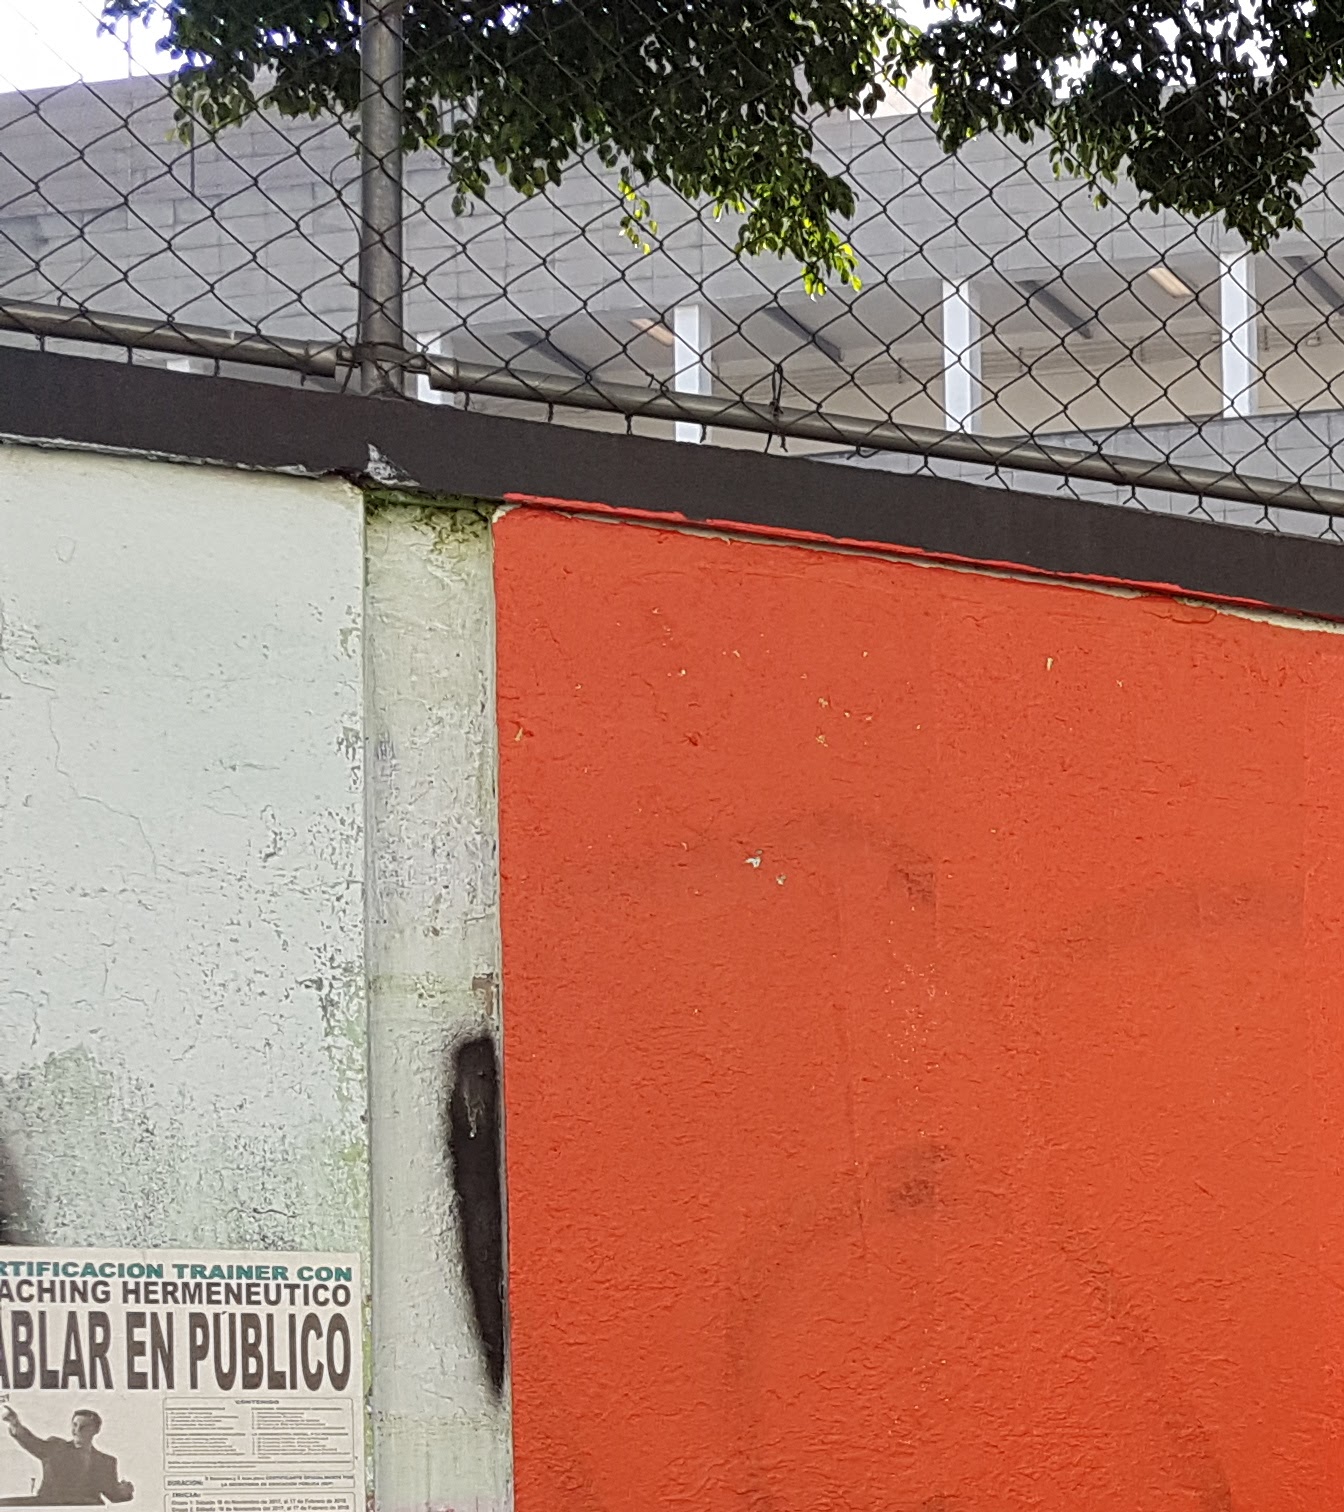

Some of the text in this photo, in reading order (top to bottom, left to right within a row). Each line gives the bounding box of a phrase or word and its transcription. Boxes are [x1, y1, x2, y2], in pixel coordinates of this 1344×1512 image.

[172, 1263, 289, 1281] TRAINER
[296, 1265, 352, 1282] CON
[0, 1279, 351, 1307] ACHING HERMENEUTICO
[126, 1311, 175, 1390] EN
[188, 1310, 351, 1392] PÚBLICO
